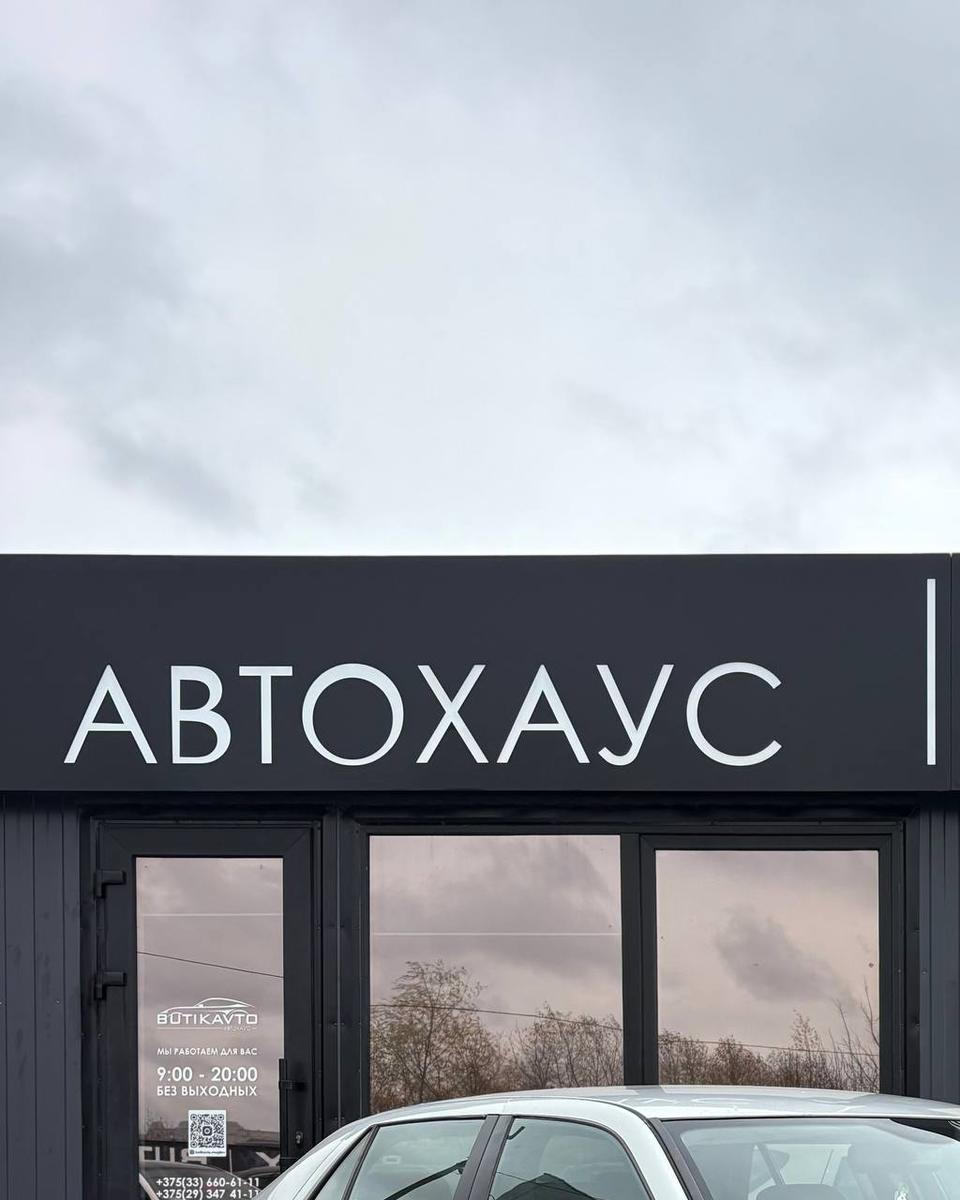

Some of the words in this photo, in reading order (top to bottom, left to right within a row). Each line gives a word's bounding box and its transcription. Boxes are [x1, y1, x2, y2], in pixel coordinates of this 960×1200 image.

[64, 662, 782, 766] АВТОХАУС
[157, 1013, 258, 1024] BUTIKAVTO
[221, 1048, 238, 1056] ДЛЯ
[157, 1067, 193, 1081] 9:00
[211, 1067, 258, 1081] 20:00
[157, 1086, 177, 1096] БЕЗ
[181, 1086, 257, 1097] ВЫХОДНЫХ
[156, 1177, 203, 1189] +375(33)
[206, 1177, 260, 1187] 660-61-11
[156, 1189, 203, 1200] +375(29)
